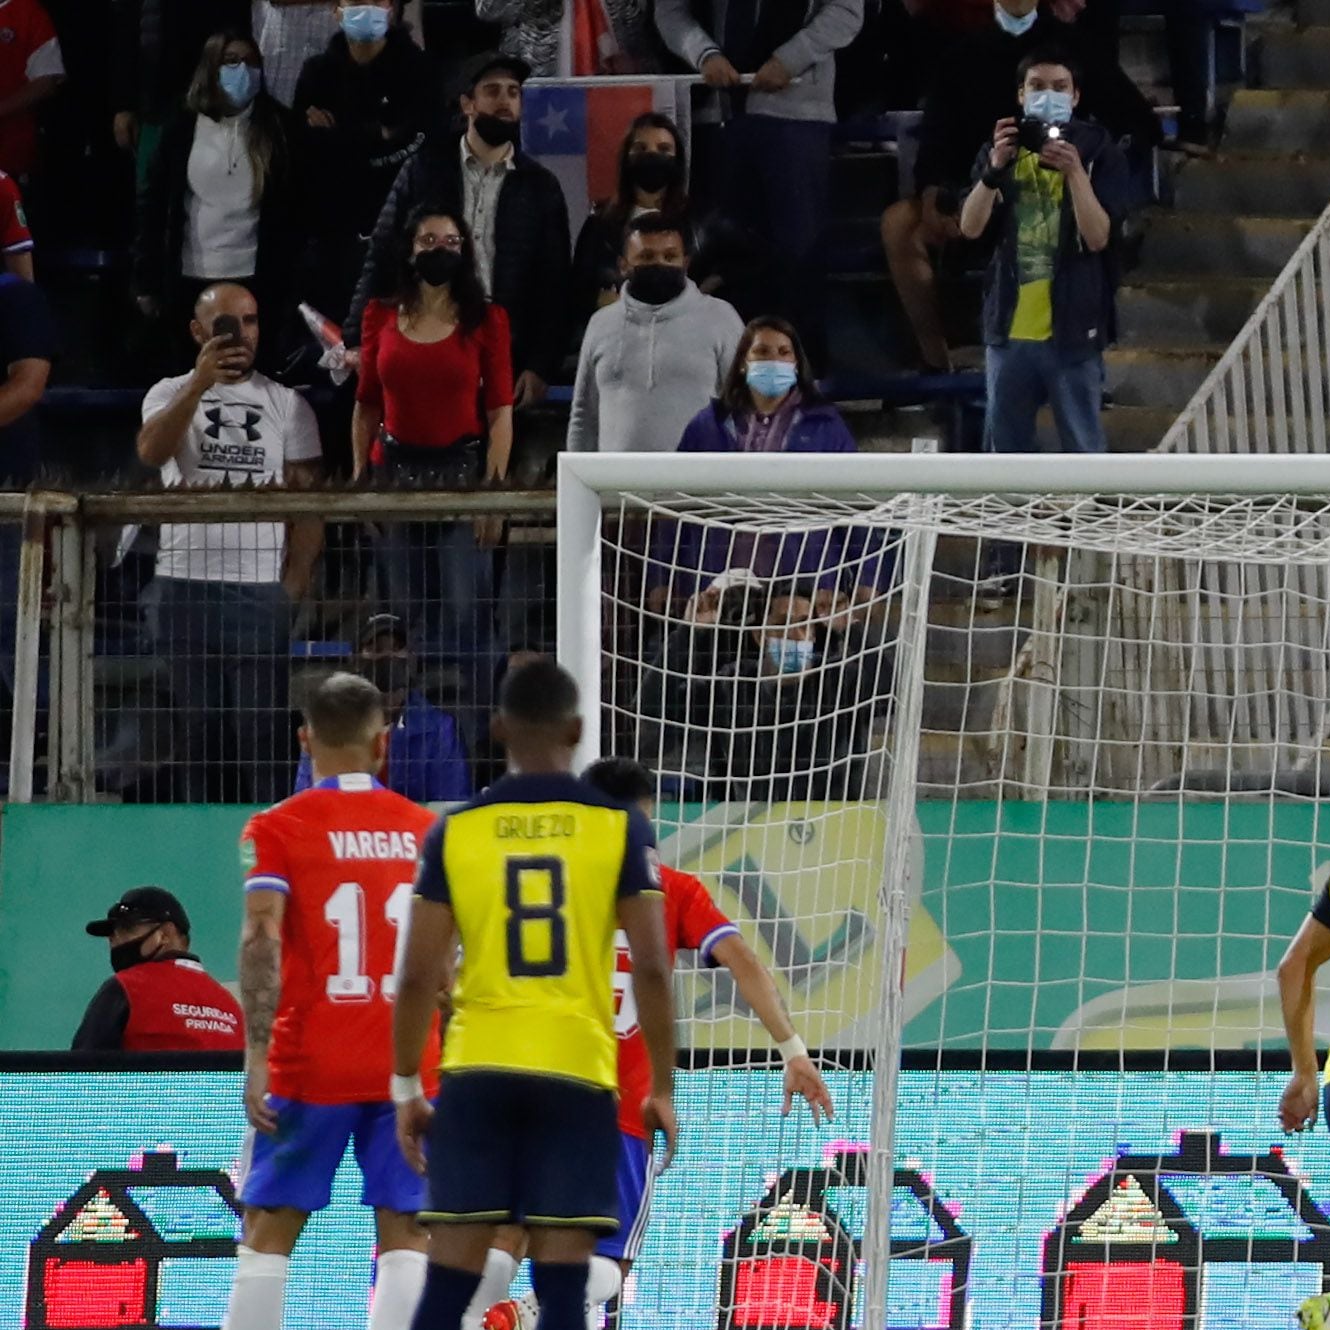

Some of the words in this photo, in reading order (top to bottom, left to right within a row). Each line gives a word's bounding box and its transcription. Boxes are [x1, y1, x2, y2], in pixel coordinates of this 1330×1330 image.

[200, 443, 265, 457] UNDER
[201, 453, 264, 466] ARMOUR
[495, 815, 575, 839] GRUEZO
[328, 831, 418, 860] VARGAS
[506, 855, 567, 978] 8
[185, 1018, 234, 1034] PRIVADA
